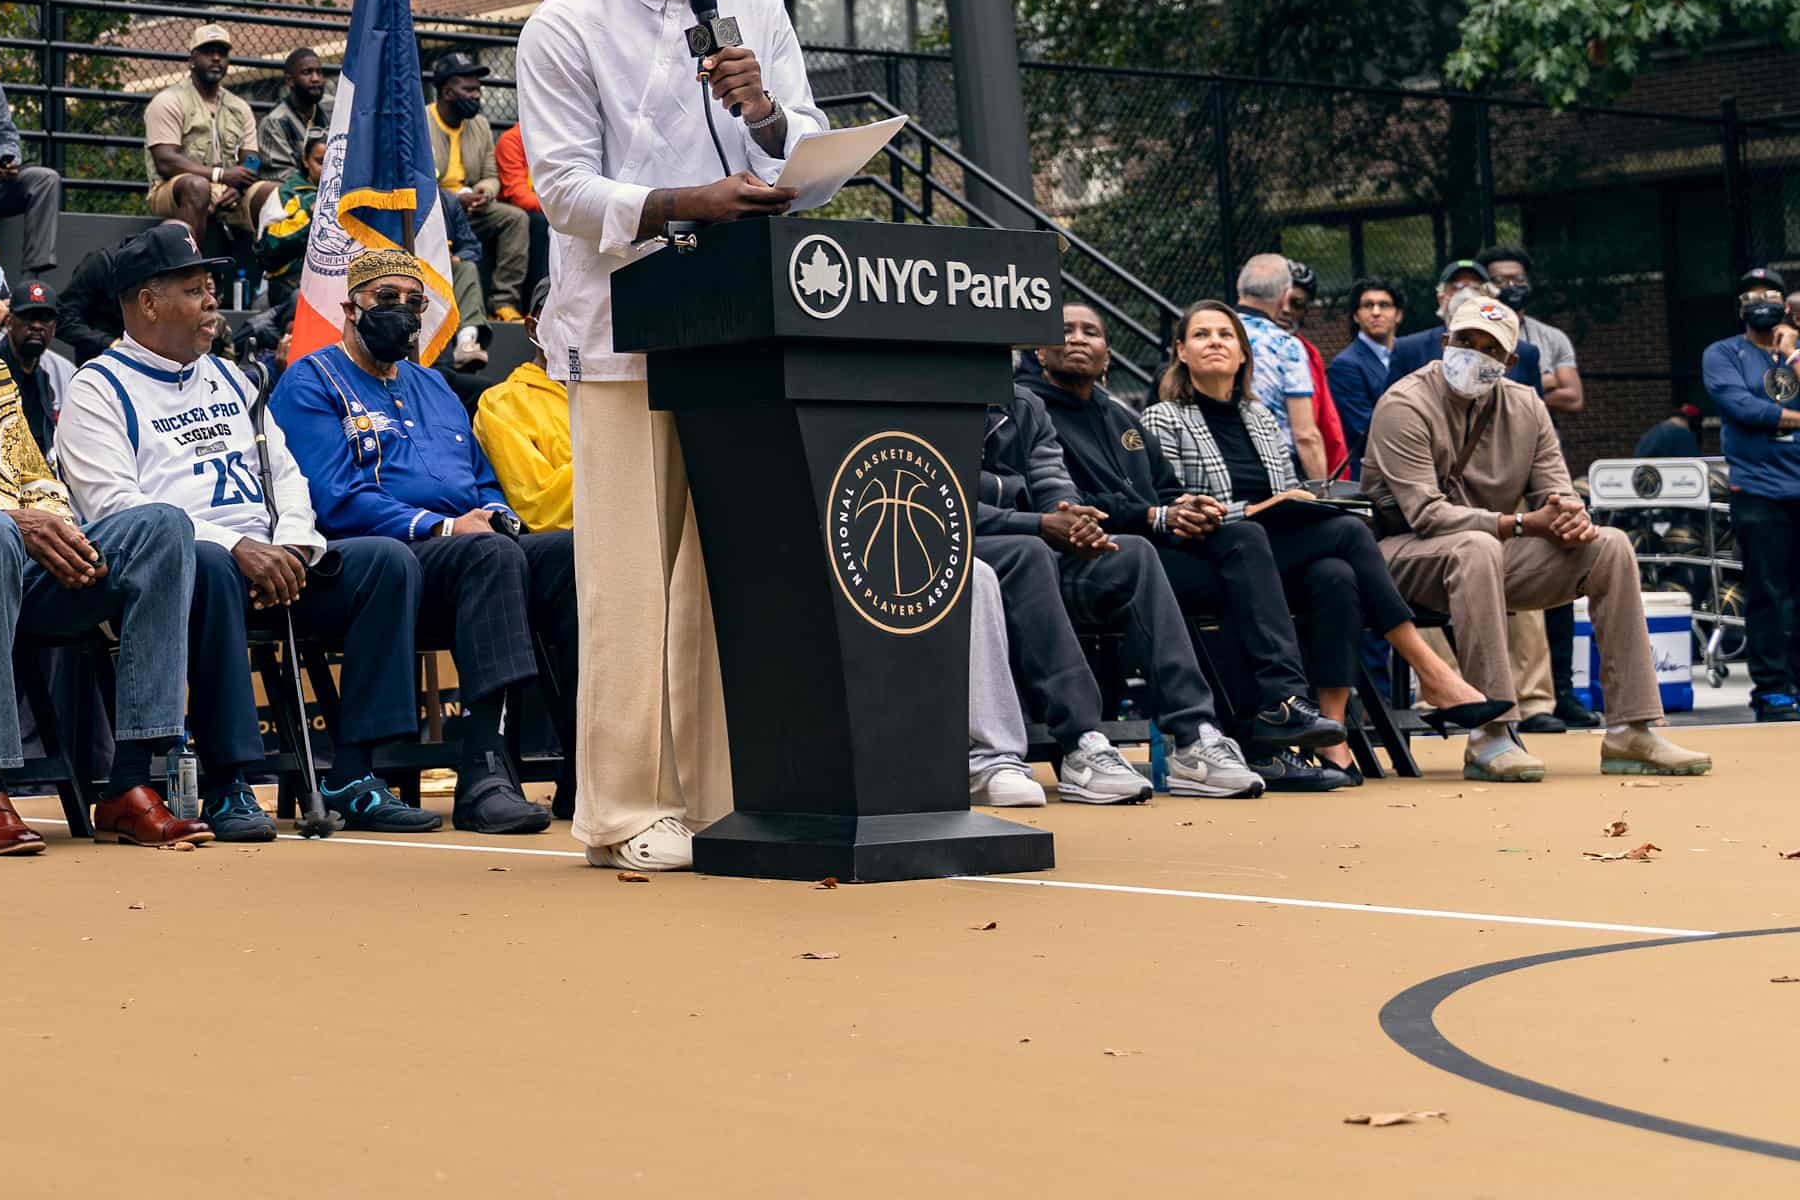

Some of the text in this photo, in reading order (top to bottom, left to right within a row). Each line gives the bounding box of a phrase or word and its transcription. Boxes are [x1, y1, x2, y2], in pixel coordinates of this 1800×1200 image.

[859, 256, 1052, 312] NYC Parks
[152, 402, 241, 433] RUCKER PRO
[174, 423, 231, 446] LEGENDS
[193, 451, 264, 508] 20
[855, 449, 937, 480] BASKETBALL
[839, 487, 863, 587] NATIONAL
[927, 483, 960, 607] ASSOCIATION
[864, 588, 924, 616] PLAYERS
